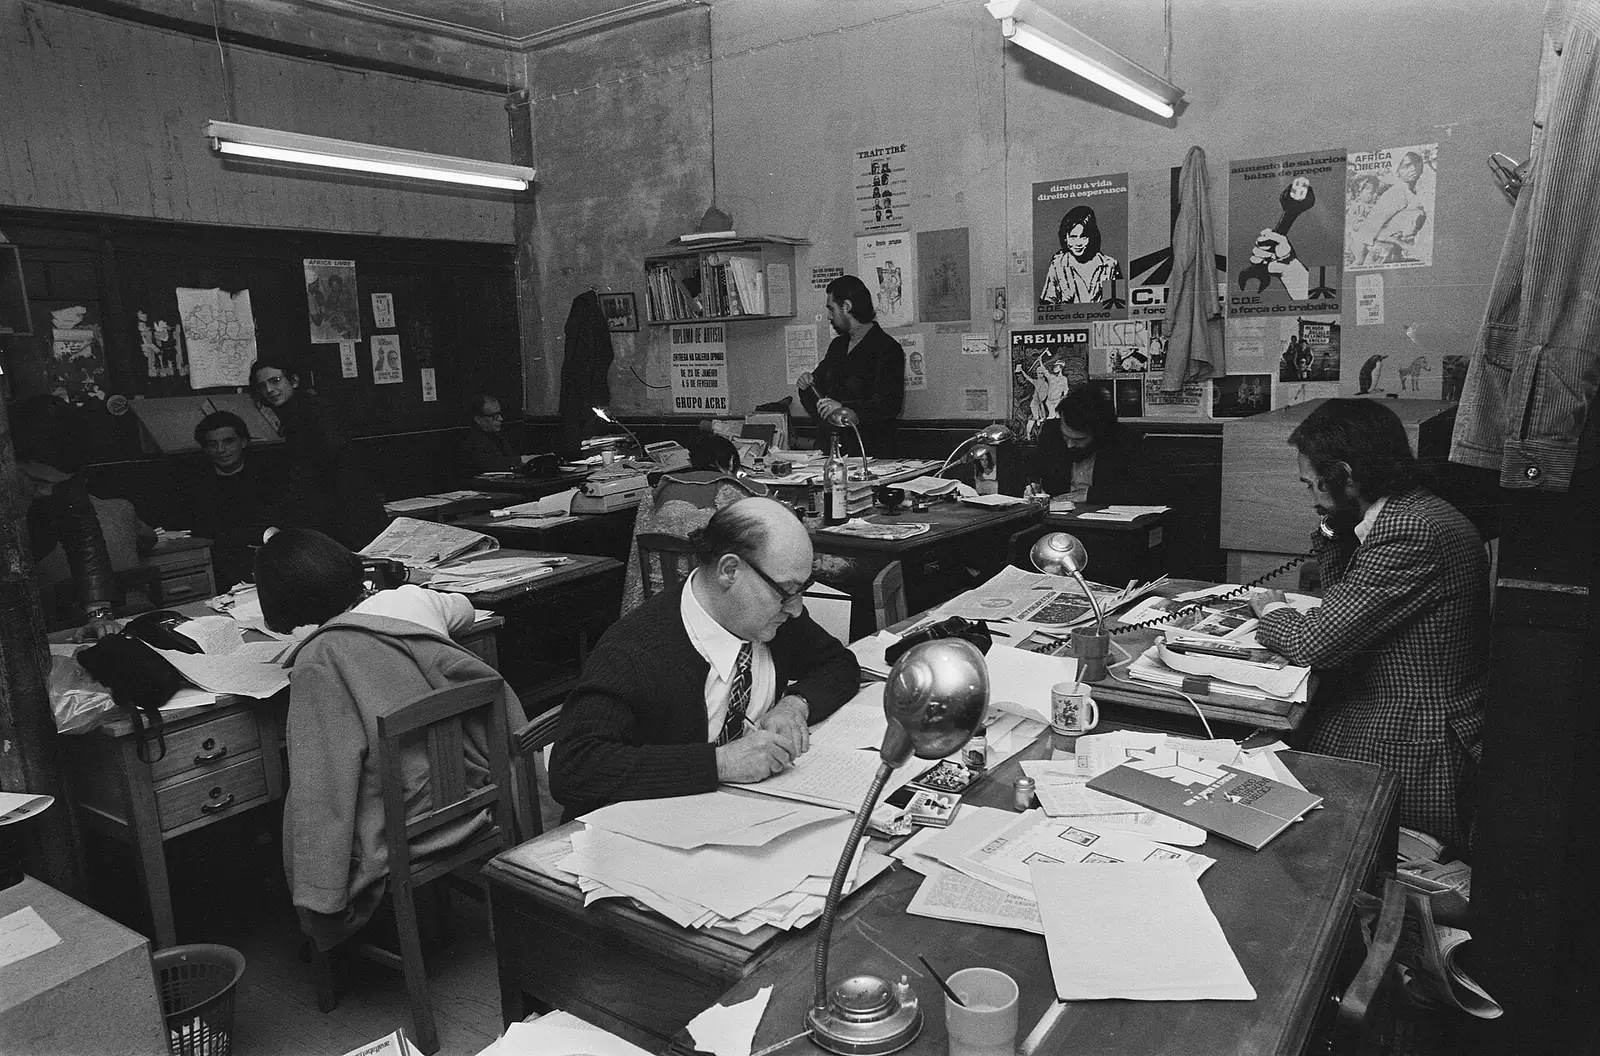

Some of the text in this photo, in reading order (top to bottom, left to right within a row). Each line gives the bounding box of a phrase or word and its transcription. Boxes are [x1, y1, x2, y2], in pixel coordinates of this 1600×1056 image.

[1281, 160, 1296, 169] de
[1244, 165, 1332, 181] baixa de preços
[1050, 183, 1082, 192] direito
[1090, 180, 1112, 188] vida
[1037, 192, 1069, 201] direito
[1077, 186, 1128, 197] esperança
[1239, 305, 1270, 314] força
[1272, 304, 1286, 312] do
[1288, 302, 1339, 312] trabalho
[1044, 313, 1071, 321] força
[1086, 312, 1111, 320] povo
[675, 397, 727, 409] GRUPO ACRE
